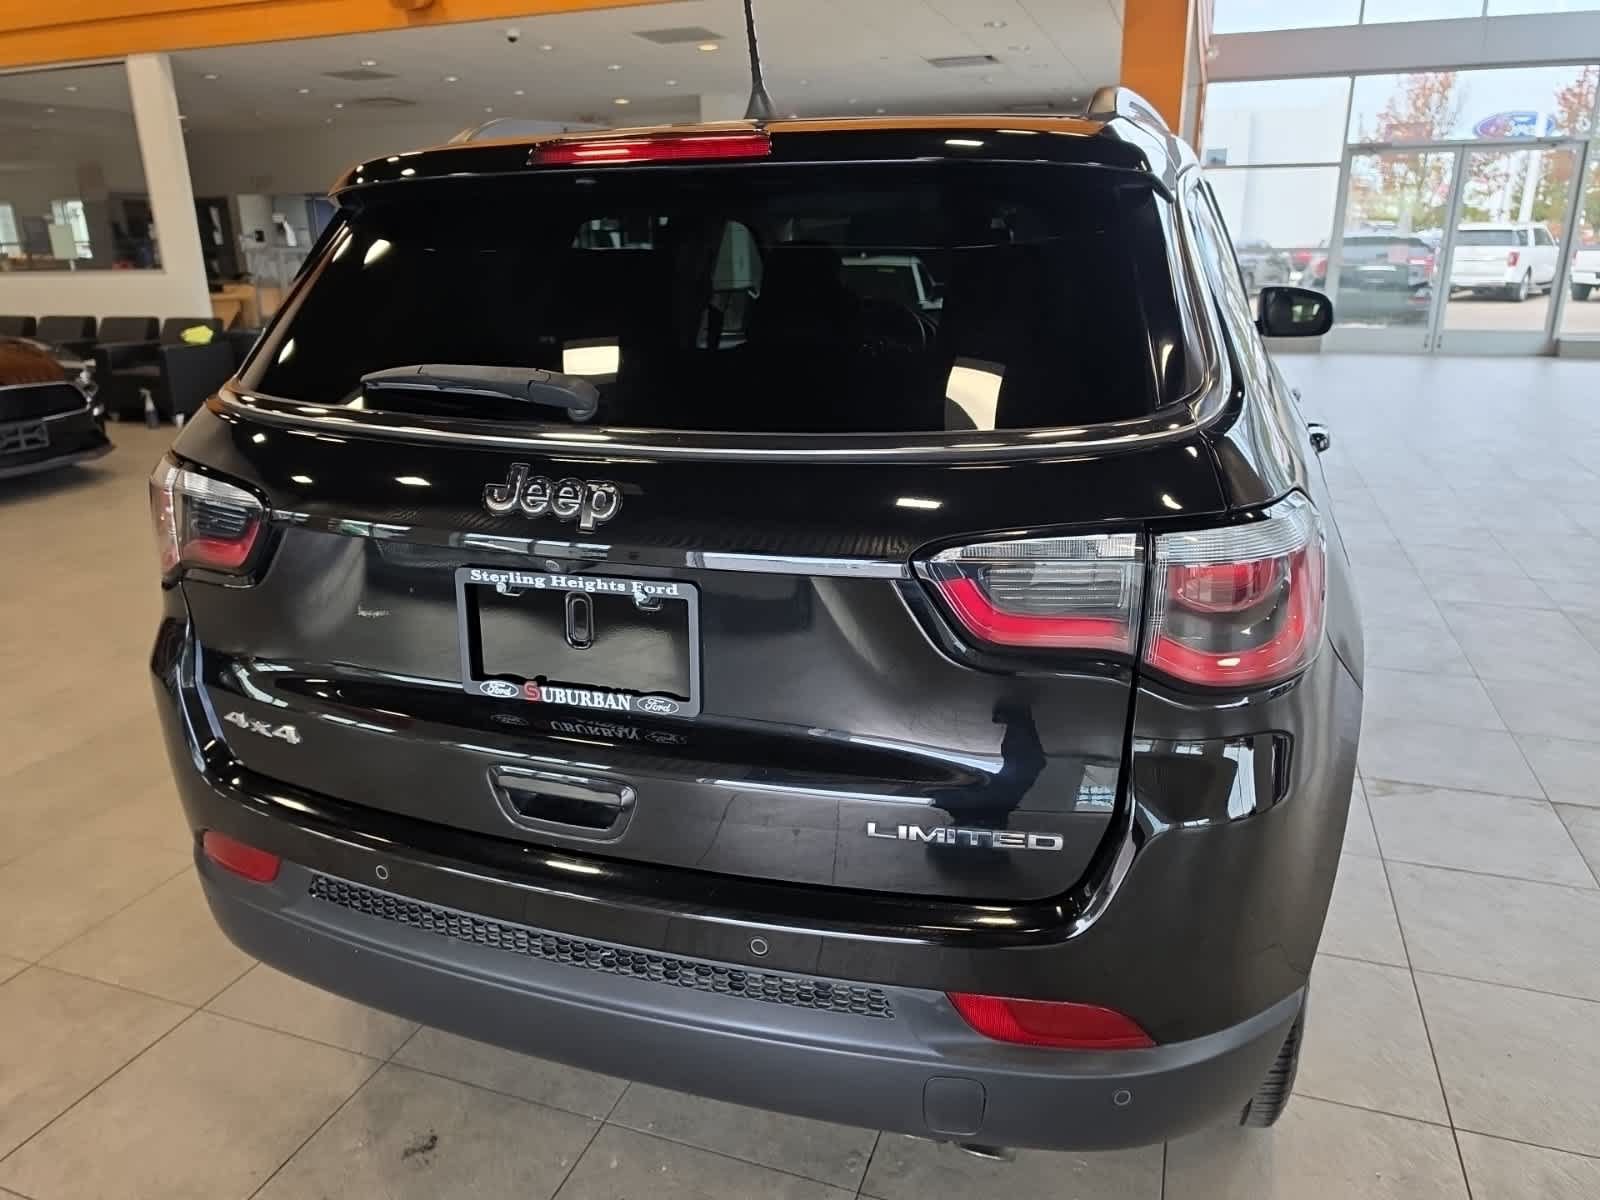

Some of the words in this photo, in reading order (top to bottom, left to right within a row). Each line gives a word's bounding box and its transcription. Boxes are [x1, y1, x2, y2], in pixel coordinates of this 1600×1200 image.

[484, 463, 622, 534] Jeep
[470, 569, 545, 588] Sterling
[550, 575, 626, 593] Heights
[631, 581, 679, 596] Ford
[487, 681, 514, 697] Ford
[523, 681, 632, 711] SUBURBAN
[643, 697, 672, 713] Ford
[224, 711, 301, 745] 4x4
[867, 822, 1064, 851] LIMITED
